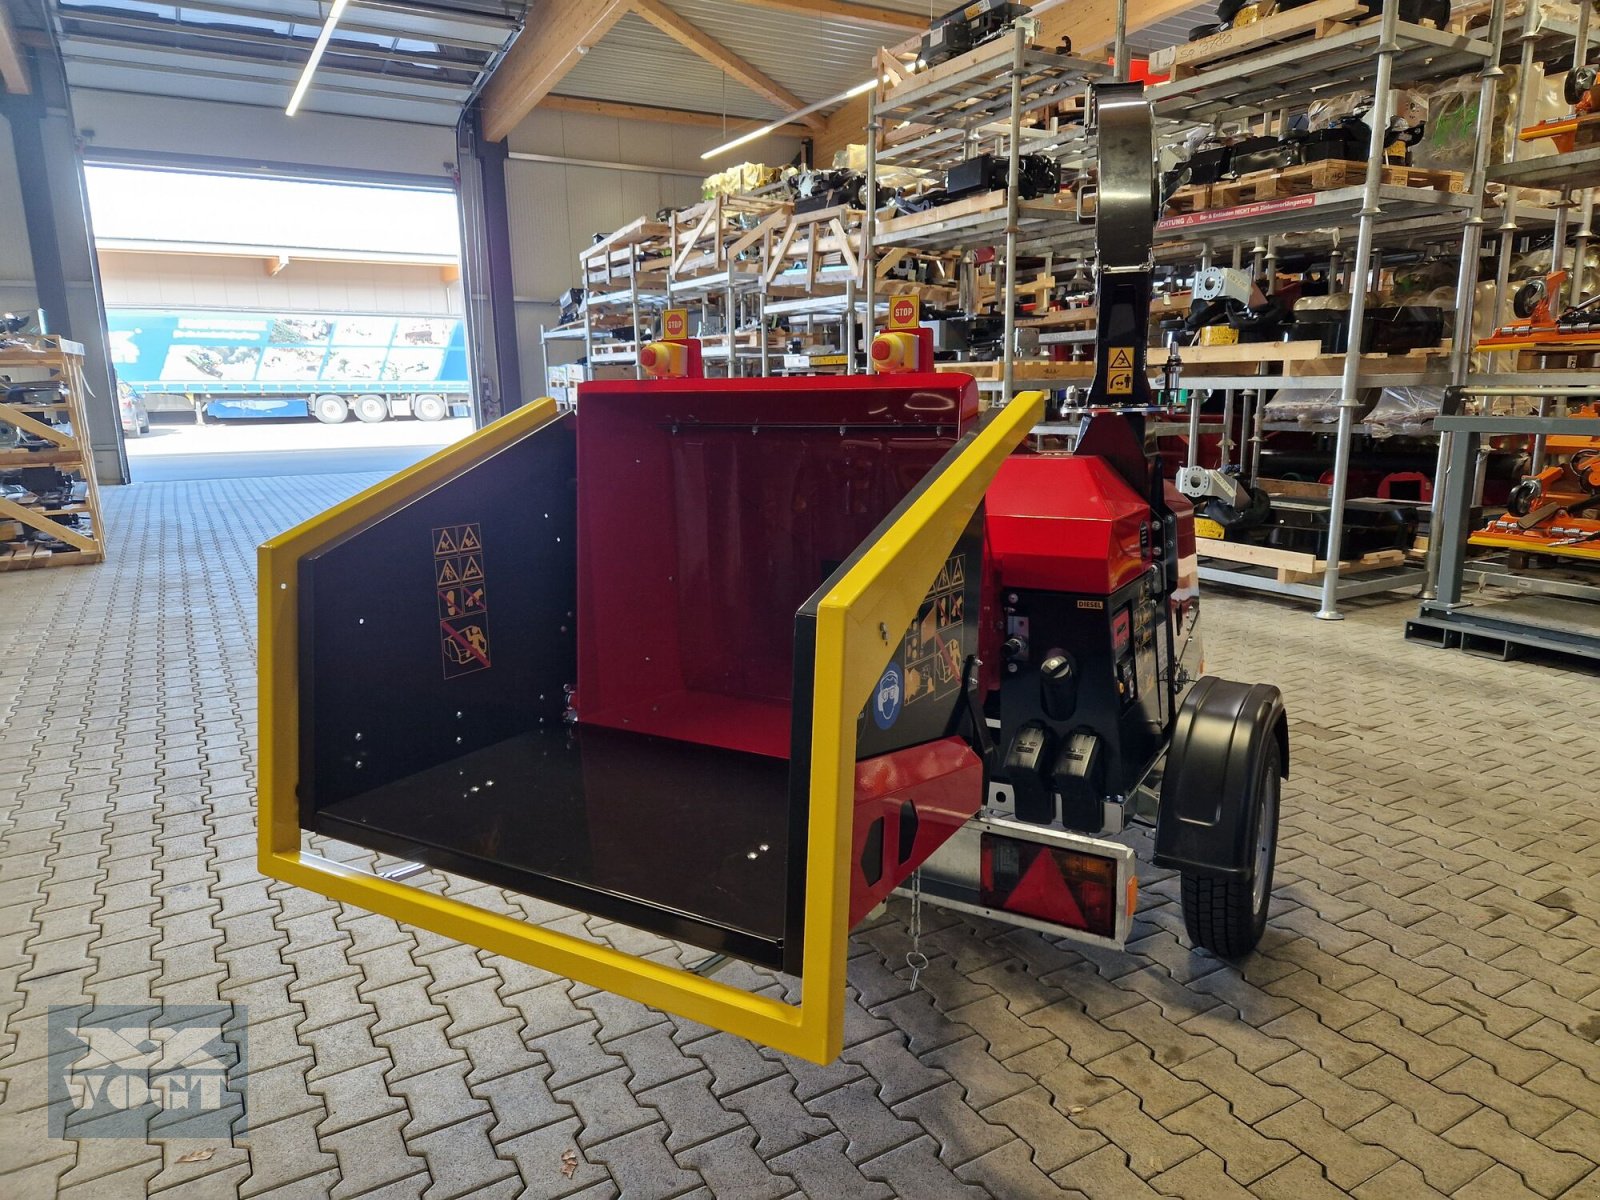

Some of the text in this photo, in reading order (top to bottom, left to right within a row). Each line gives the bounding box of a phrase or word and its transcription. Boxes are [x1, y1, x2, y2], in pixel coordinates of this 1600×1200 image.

[1235, 207, 1250, 216] NICHT
[895, 307, 913, 317] STOP
[667, 320, 682, 329] STOP
[1078, 601, 1102, 609] DIESEL
